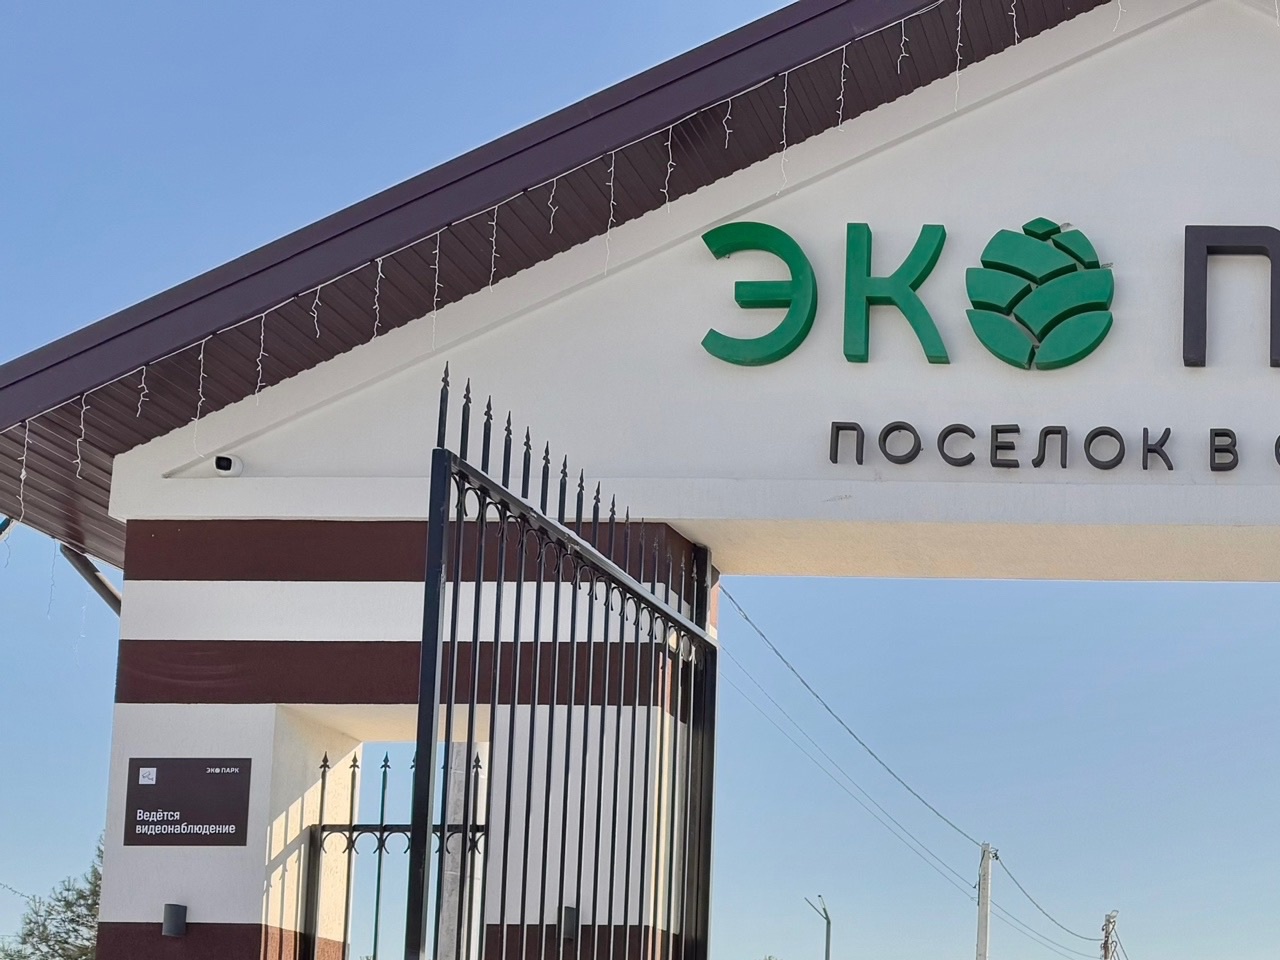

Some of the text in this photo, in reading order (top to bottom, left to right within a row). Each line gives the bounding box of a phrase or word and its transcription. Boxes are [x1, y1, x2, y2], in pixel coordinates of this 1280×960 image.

[829, 421, 1174, 471] ПОСЕЛОК
[1209, 428, 1239, 472] В
[136, 808, 180, 822] Ведётся
[135, 822, 236, 835] видеонаблюдение
